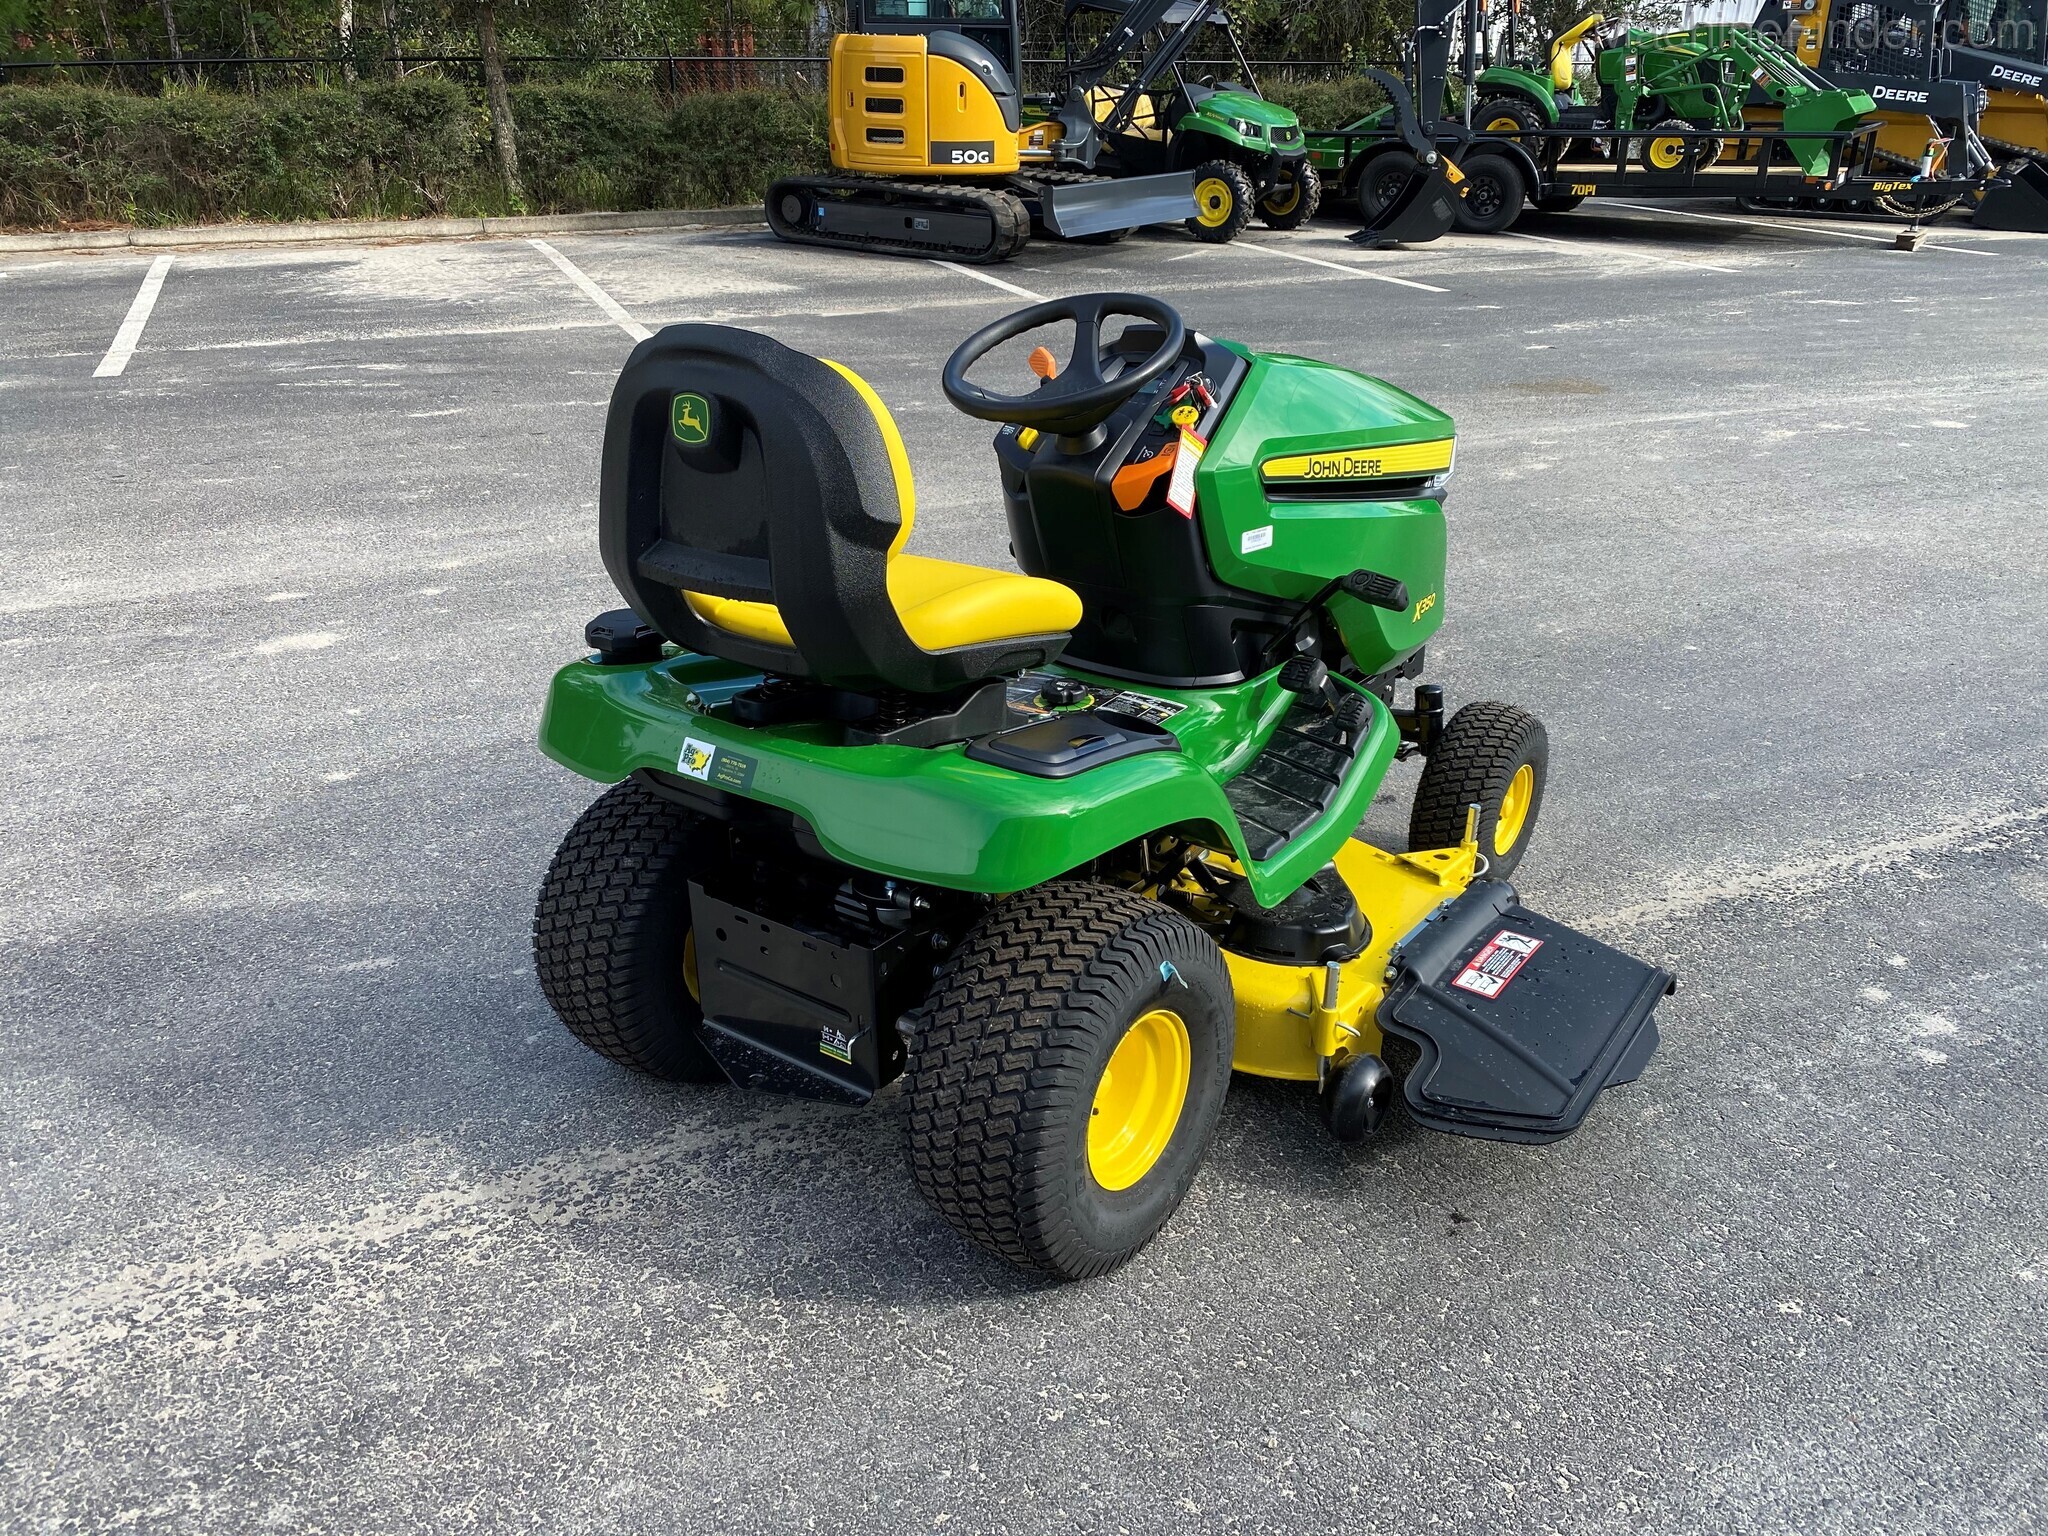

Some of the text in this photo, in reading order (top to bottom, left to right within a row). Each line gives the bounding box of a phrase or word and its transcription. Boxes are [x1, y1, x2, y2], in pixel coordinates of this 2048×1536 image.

[1990, 64, 2043, 87] DEERE
[1872, 85, 1930, 104] DEERE
[951, 149, 990, 165] 50G
[1872, 181, 1913, 193] BigTex
[1303, 457, 1383, 477] JOHN DEERE
[1412, 592, 1437, 624] X350
